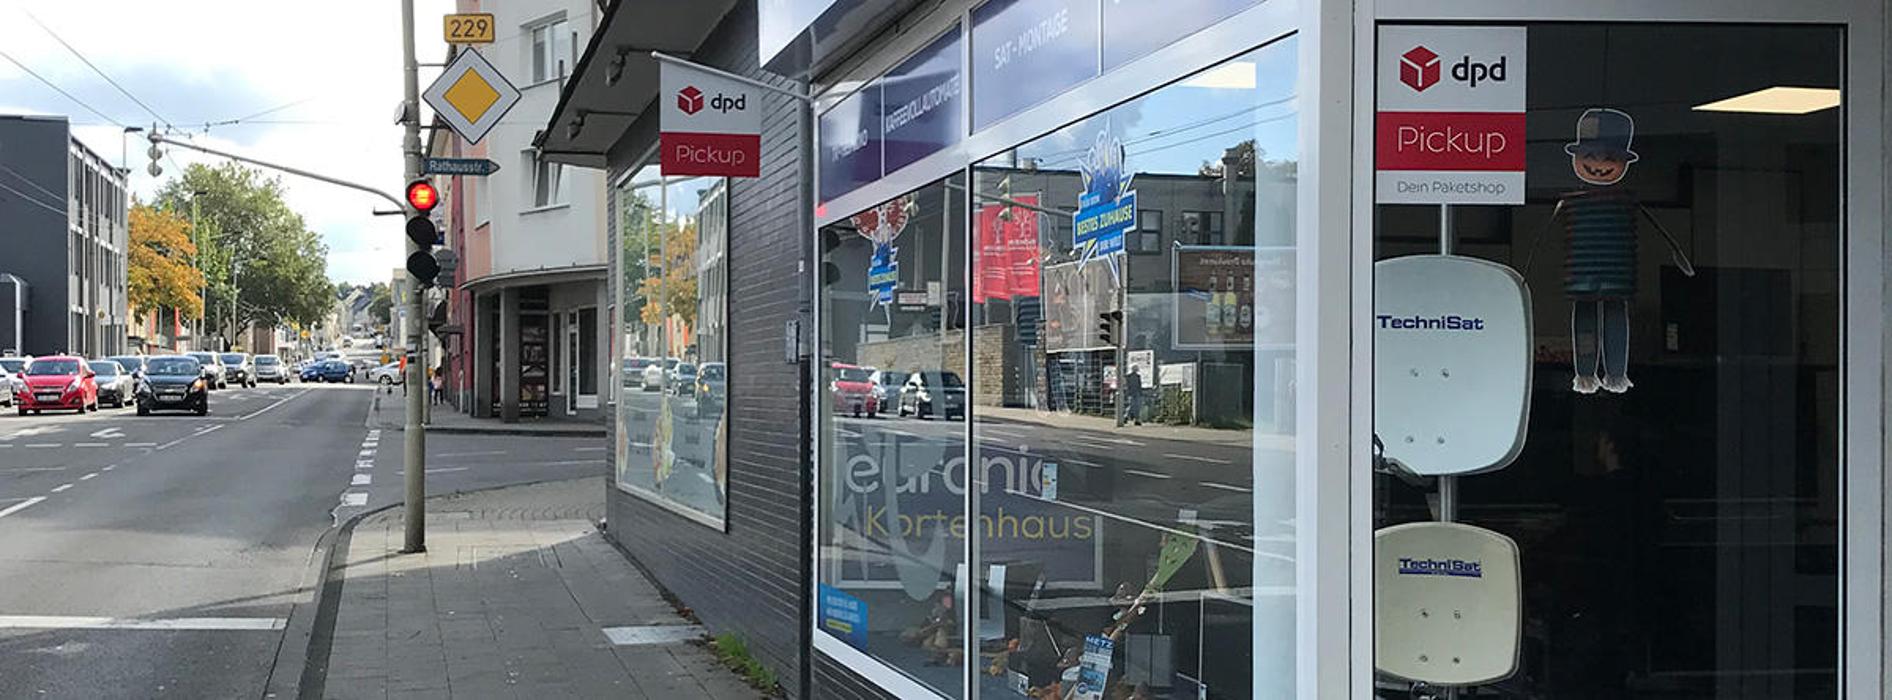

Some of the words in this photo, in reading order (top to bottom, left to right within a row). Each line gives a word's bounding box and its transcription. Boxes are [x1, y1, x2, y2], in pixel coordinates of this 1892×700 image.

[450, 18, 489, 39] 229
[1451, 55, 1507, 88] dpd
[710, 93, 746, 114] dpd
[1397, 125, 1506, 158] Pickup
[676, 145, 746, 165] Pickup
[429, 160, 485, 173] Rathausstr.
[1397, 180, 1429, 194] Dein
[1432, 180, 1506, 196] Paketshop
[1099, 204, 1133, 228] ZUHAUSE
[1377, 315, 1484, 331] TechniSat
[866, 504, 1092, 540] Kortenhaus
[1399, 558, 1481, 572] TechniSat
[1085, 636, 1114, 649] METZ
